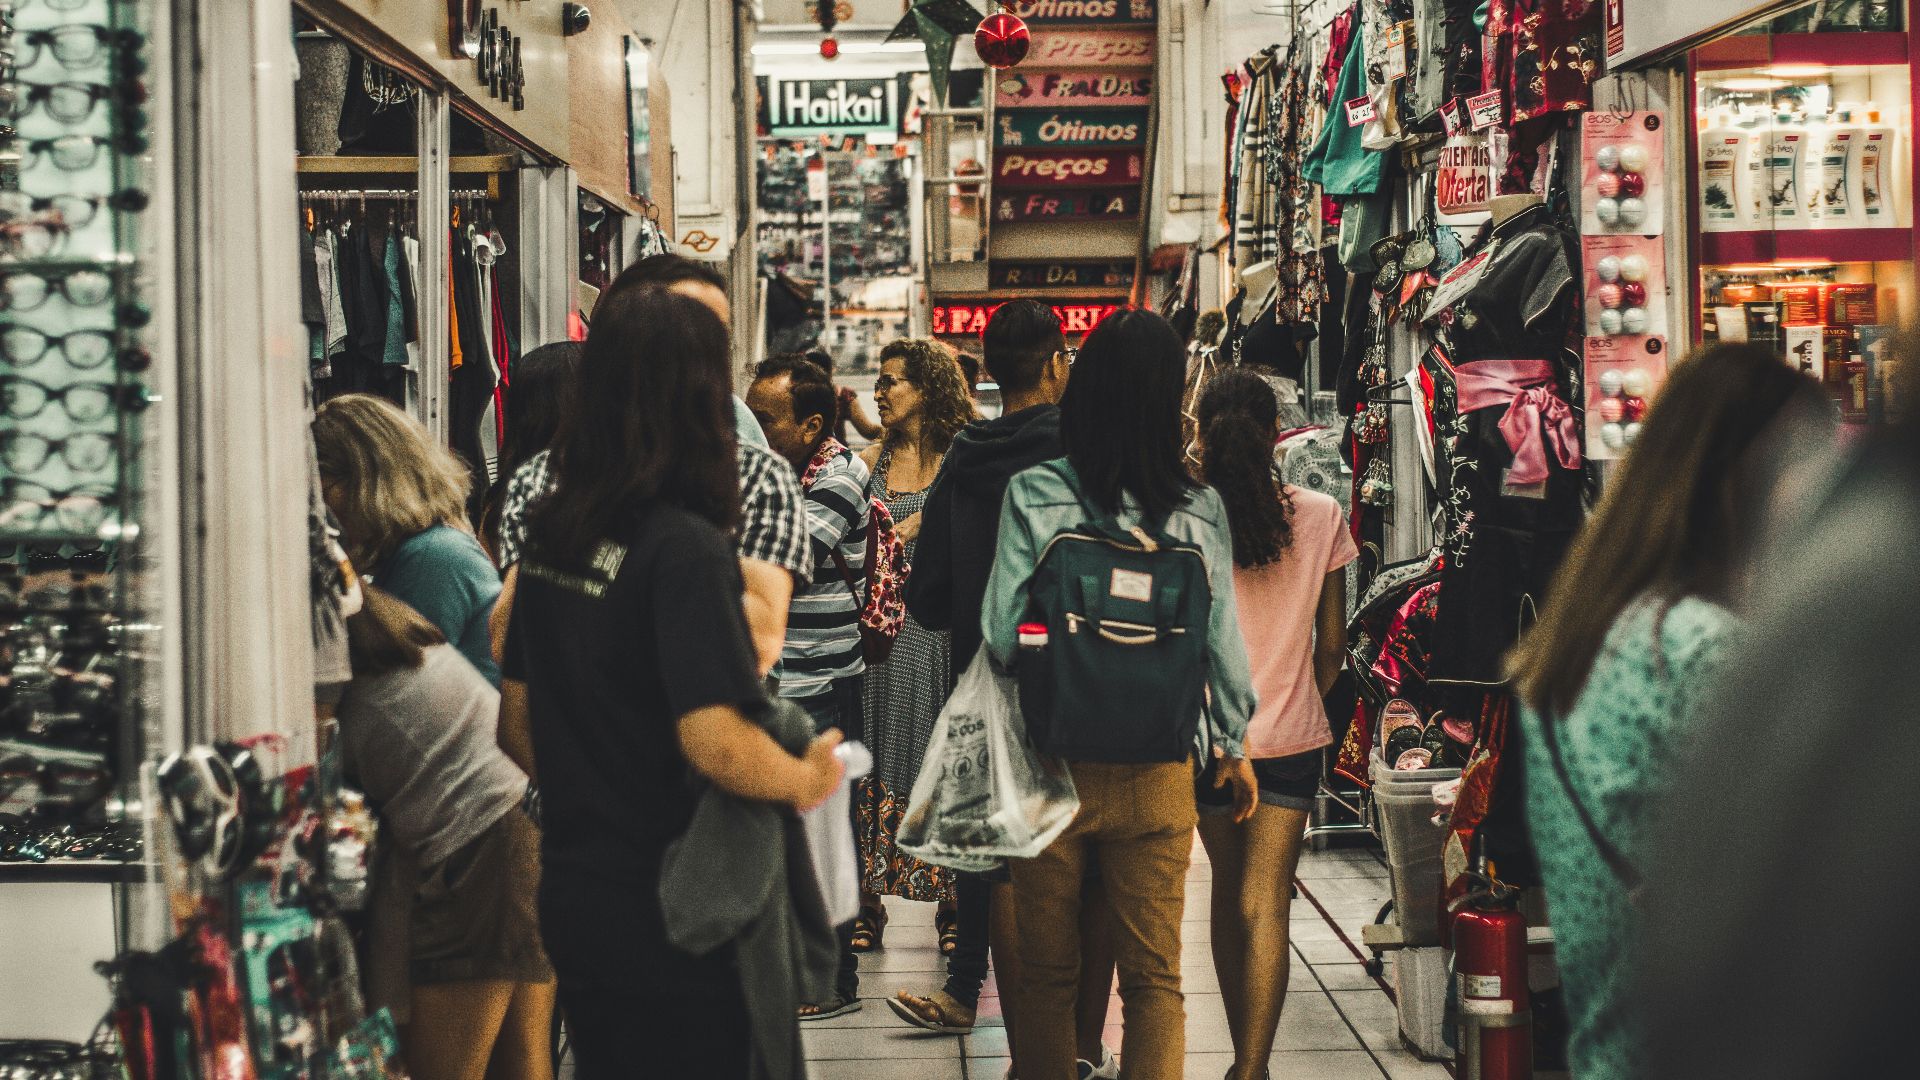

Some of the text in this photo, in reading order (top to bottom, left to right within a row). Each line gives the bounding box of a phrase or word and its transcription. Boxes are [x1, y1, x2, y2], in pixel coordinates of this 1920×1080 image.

[1046, 35, 1150, 62] Preços
[785, 80, 883, 124] Haikai
[1038, 114, 1138, 141] Ótimos
[1588, 115, 1612, 124] eos
[1001, 154, 1109, 180] Preços
[1437, 167, 1487, 205] Oferta
[1589, 339, 1613, 348] eos
